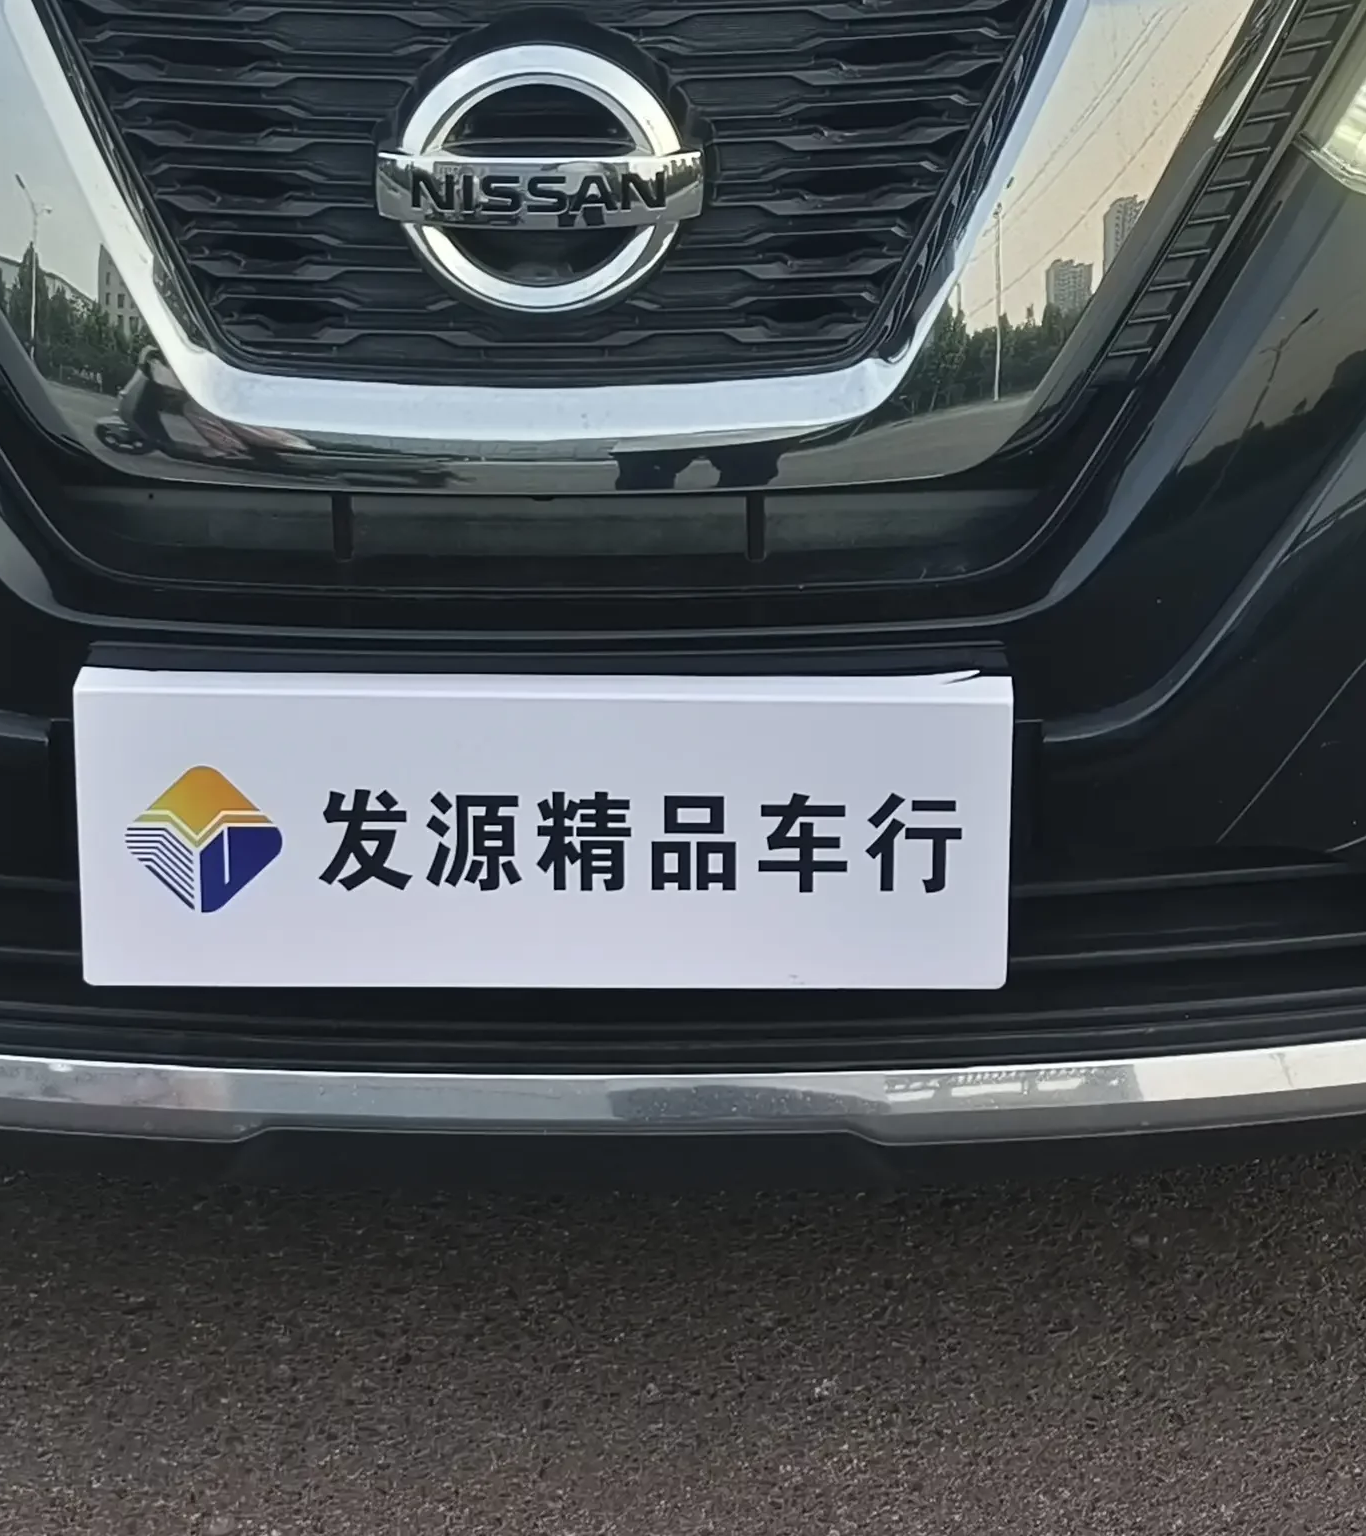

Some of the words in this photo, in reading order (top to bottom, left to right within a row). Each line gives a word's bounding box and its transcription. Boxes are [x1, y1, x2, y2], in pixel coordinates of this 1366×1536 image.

[410, 170, 668, 215] NISSAN
[318, 788, 963, 894] 发源精品车行
